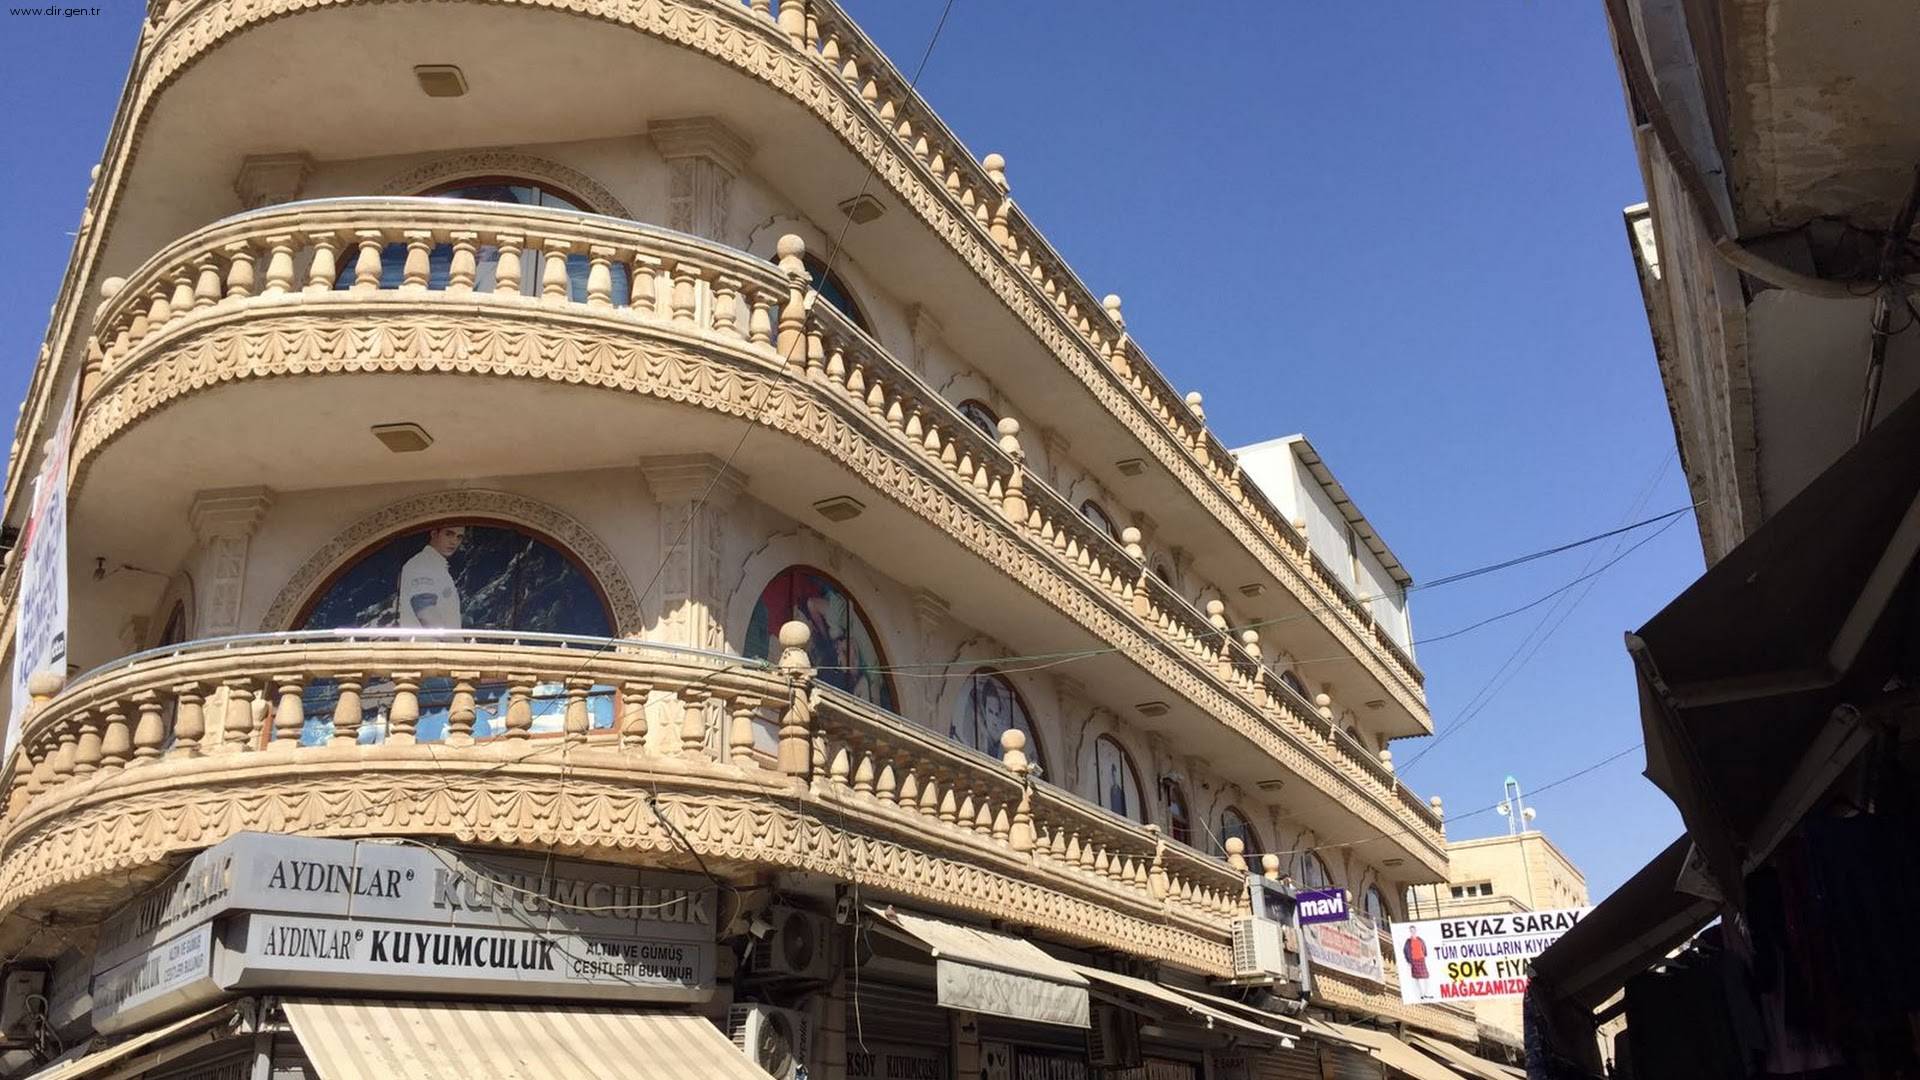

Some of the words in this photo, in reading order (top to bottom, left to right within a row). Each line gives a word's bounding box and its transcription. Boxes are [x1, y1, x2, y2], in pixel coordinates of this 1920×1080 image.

[268, 860, 401, 898] AYDINLAR
[1300, 893, 1343, 917] mavi
[1441, 918, 1507, 939] BEYAZ
[1512, 911, 1579, 933] SARAY
[264, 925, 350, 960] AYDINLAR
[370, 930, 554, 971] KUYUMCULUK
[586, 943, 619, 957] ALTIN
[623, 945, 638, 958] VE
[641, 943, 683, 965] GÜMÜŞ
[1434, 943, 1458, 960] TÜM
[1460, 940, 1522, 958] OKULLARIN
[639, 963, 693, 980] BULUNUR
[1448, 960, 1488, 982] ŞOK
[1496, 955, 1532, 978] FİYA
